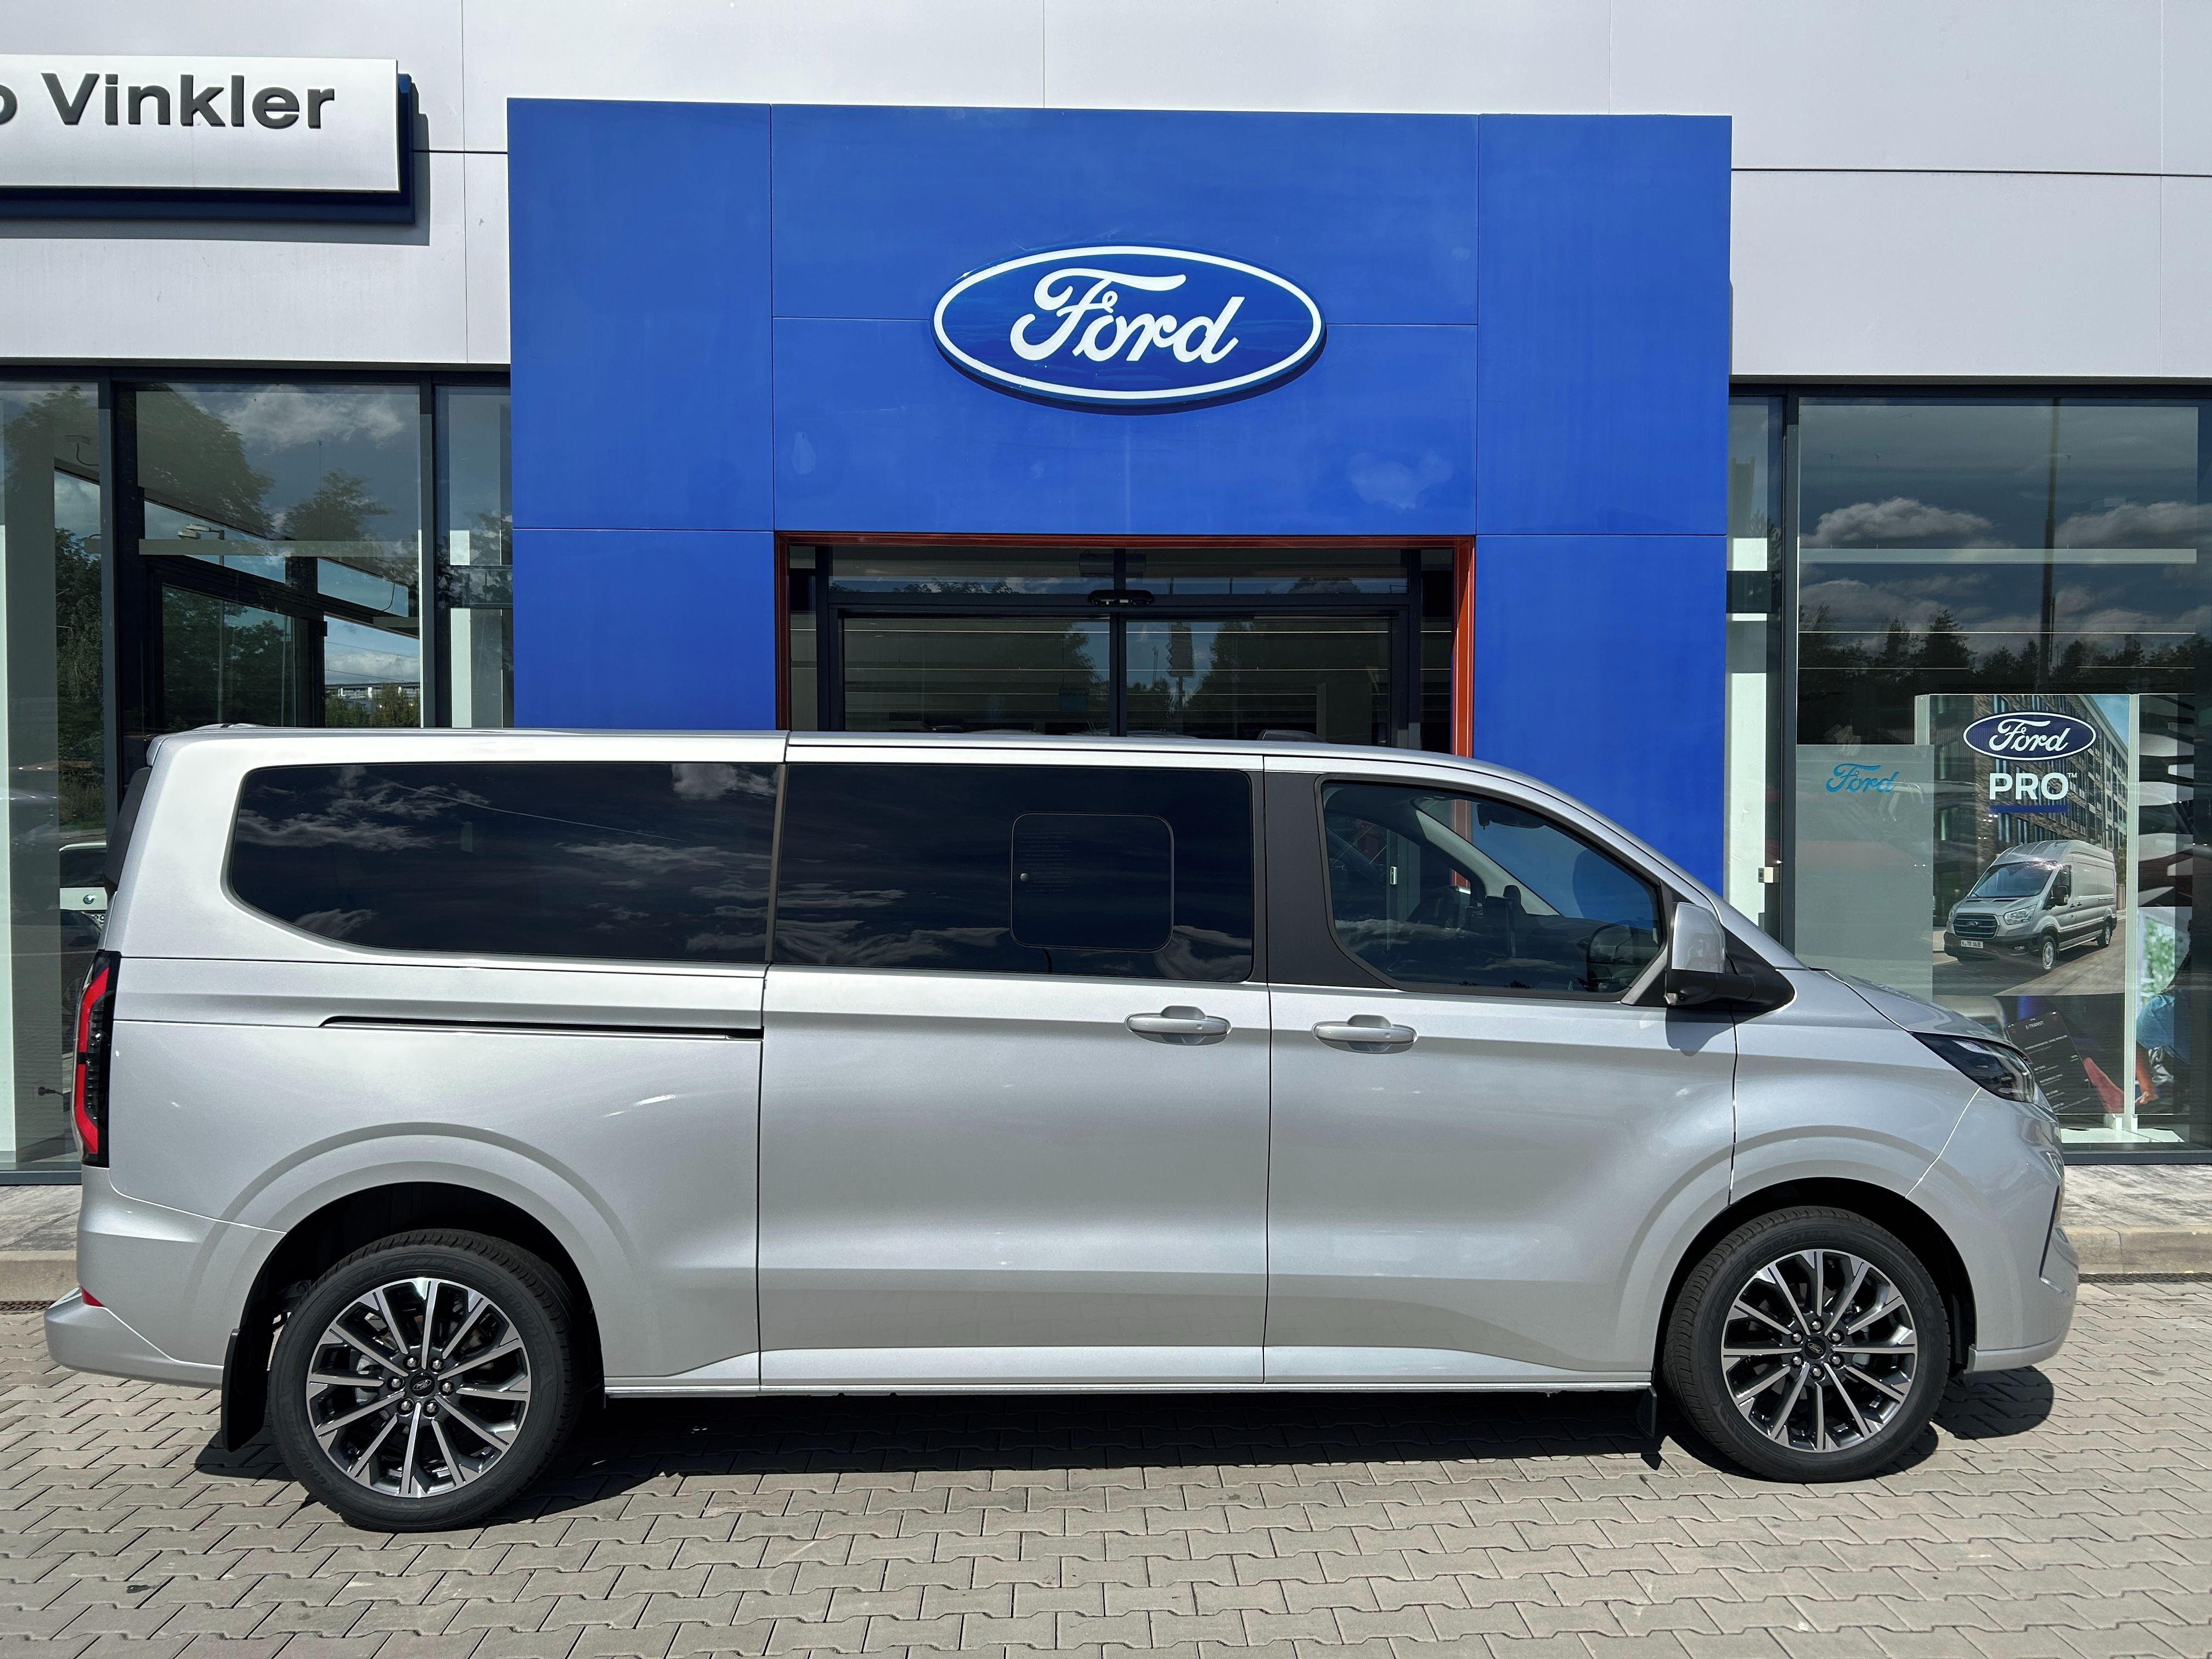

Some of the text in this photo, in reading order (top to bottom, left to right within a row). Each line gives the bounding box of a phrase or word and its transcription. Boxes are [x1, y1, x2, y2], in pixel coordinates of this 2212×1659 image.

[41, 73, 335, 129] Vinkler
[1010, 267, 1245, 364] Ford
[1989, 718, 2071, 752] Ford
[1826, 763, 1900, 793] Ford
[2025, 1020, 2045, 1030] E-TRANSIT
[1757, 1229, 1830, 1257] GOODYEAR
